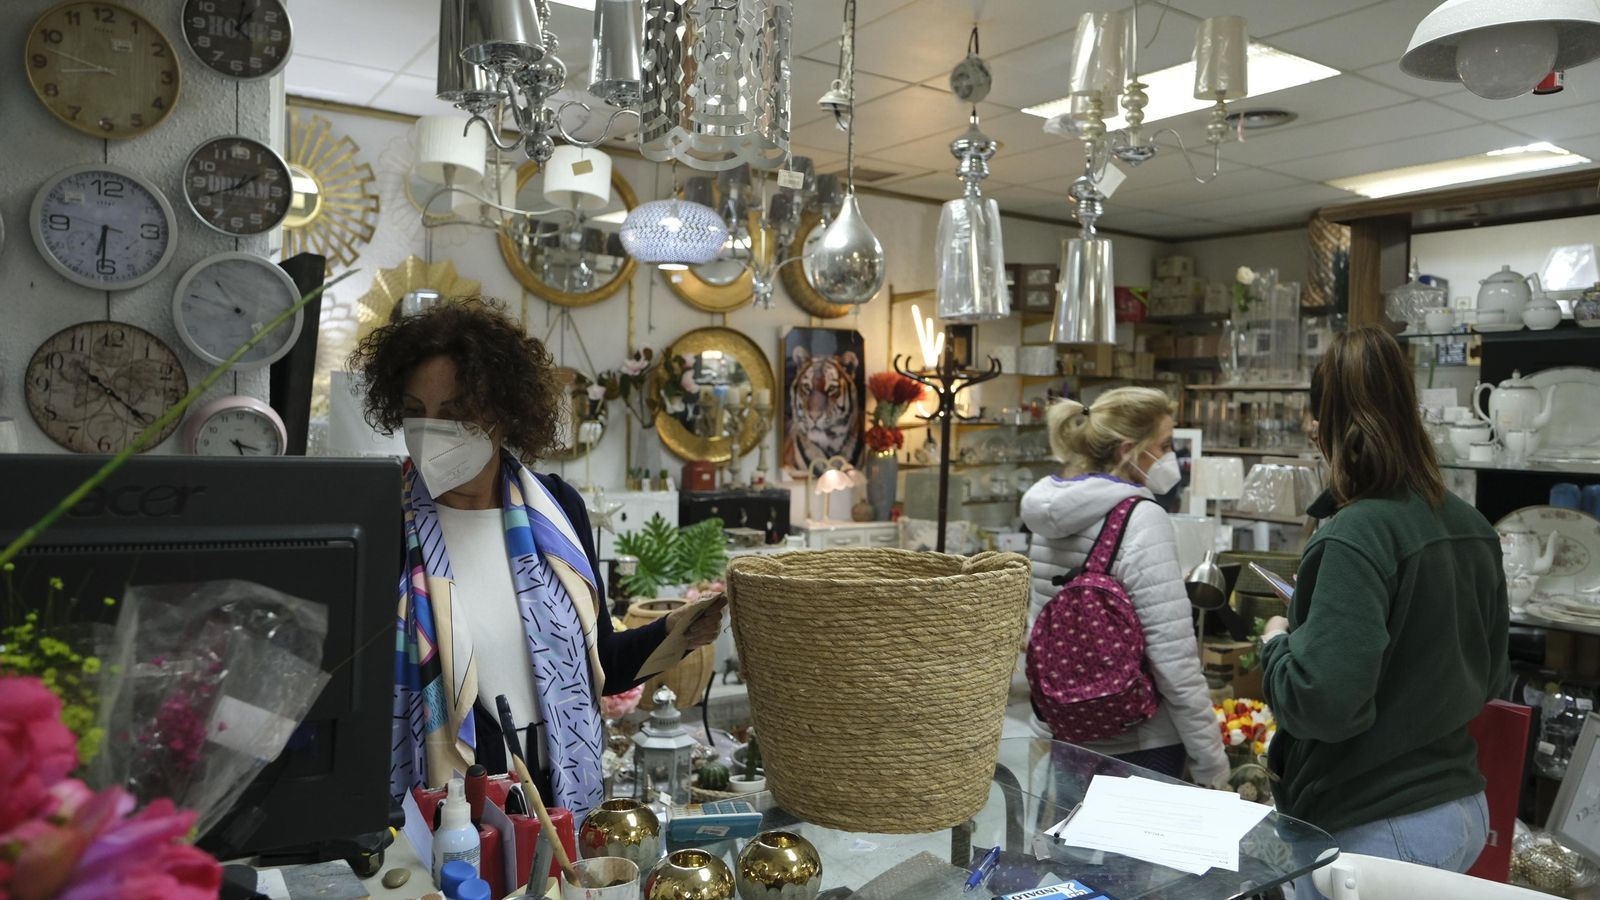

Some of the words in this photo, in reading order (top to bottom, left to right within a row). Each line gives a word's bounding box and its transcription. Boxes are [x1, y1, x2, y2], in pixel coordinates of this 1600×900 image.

[199, 0, 215, 13] 10
[65, 10, 81, 26] 11
[93, 7, 115, 23] 12
[264, 11, 278, 23] 2
[131, 20, 138, 35] 1
[192, 16, 206, 29] 9
[41, 28, 63, 44] 10
[198, 35, 211, 48] 8
[271, 29, 283, 42] 3
[151, 42, 165, 57] 2
[212, 50, 225, 61] 7
[264, 45, 275, 57] 4
[32, 53, 48, 68] 9
[230, 60, 243, 72] 6
[249, 57, 262, 69] 5
[161, 71, 174, 85] 3
[44, 83, 59, 97] 8
[152, 97, 165, 110] 4
[67, 105, 82, 120] 7
[99, 118, 114, 132] 6
[131, 113, 143, 128] 5
[214, 149, 227, 160] 11
[257, 153, 262, 164] 1
[200, 160, 216, 172] 10
[264, 168, 278, 180] 2
[90, 179, 124, 198] 12
[192, 175, 206, 188] 9
[271, 186, 283, 197] 3
[213, 208, 224, 219] 7
[264, 202, 276, 213] 4
[48, 214, 70, 232] 9
[230, 217, 244, 228] 6
[250, 213, 262, 225] 5
[140, 223, 160, 240] 3
[96, 259, 116, 275] 6
[71, 335, 84, 351] 11
[104, 329, 125, 348] 12
[145, 341, 150, 358] 1
[45, 352, 64, 370] 10
[160, 365, 173, 381] 2
[36, 377, 49, 393] 9
[44, 405, 57, 421] 8
[221, 415, 229, 424] 11
[67, 426, 81, 444] 7
[209, 427, 218, 435] 10
[97, 434, 111, 451] 6
[203, 439, 209, 447] 9
[66, 485, 208, 517] acer
[1011, 887, 1059, 900] INDALO
